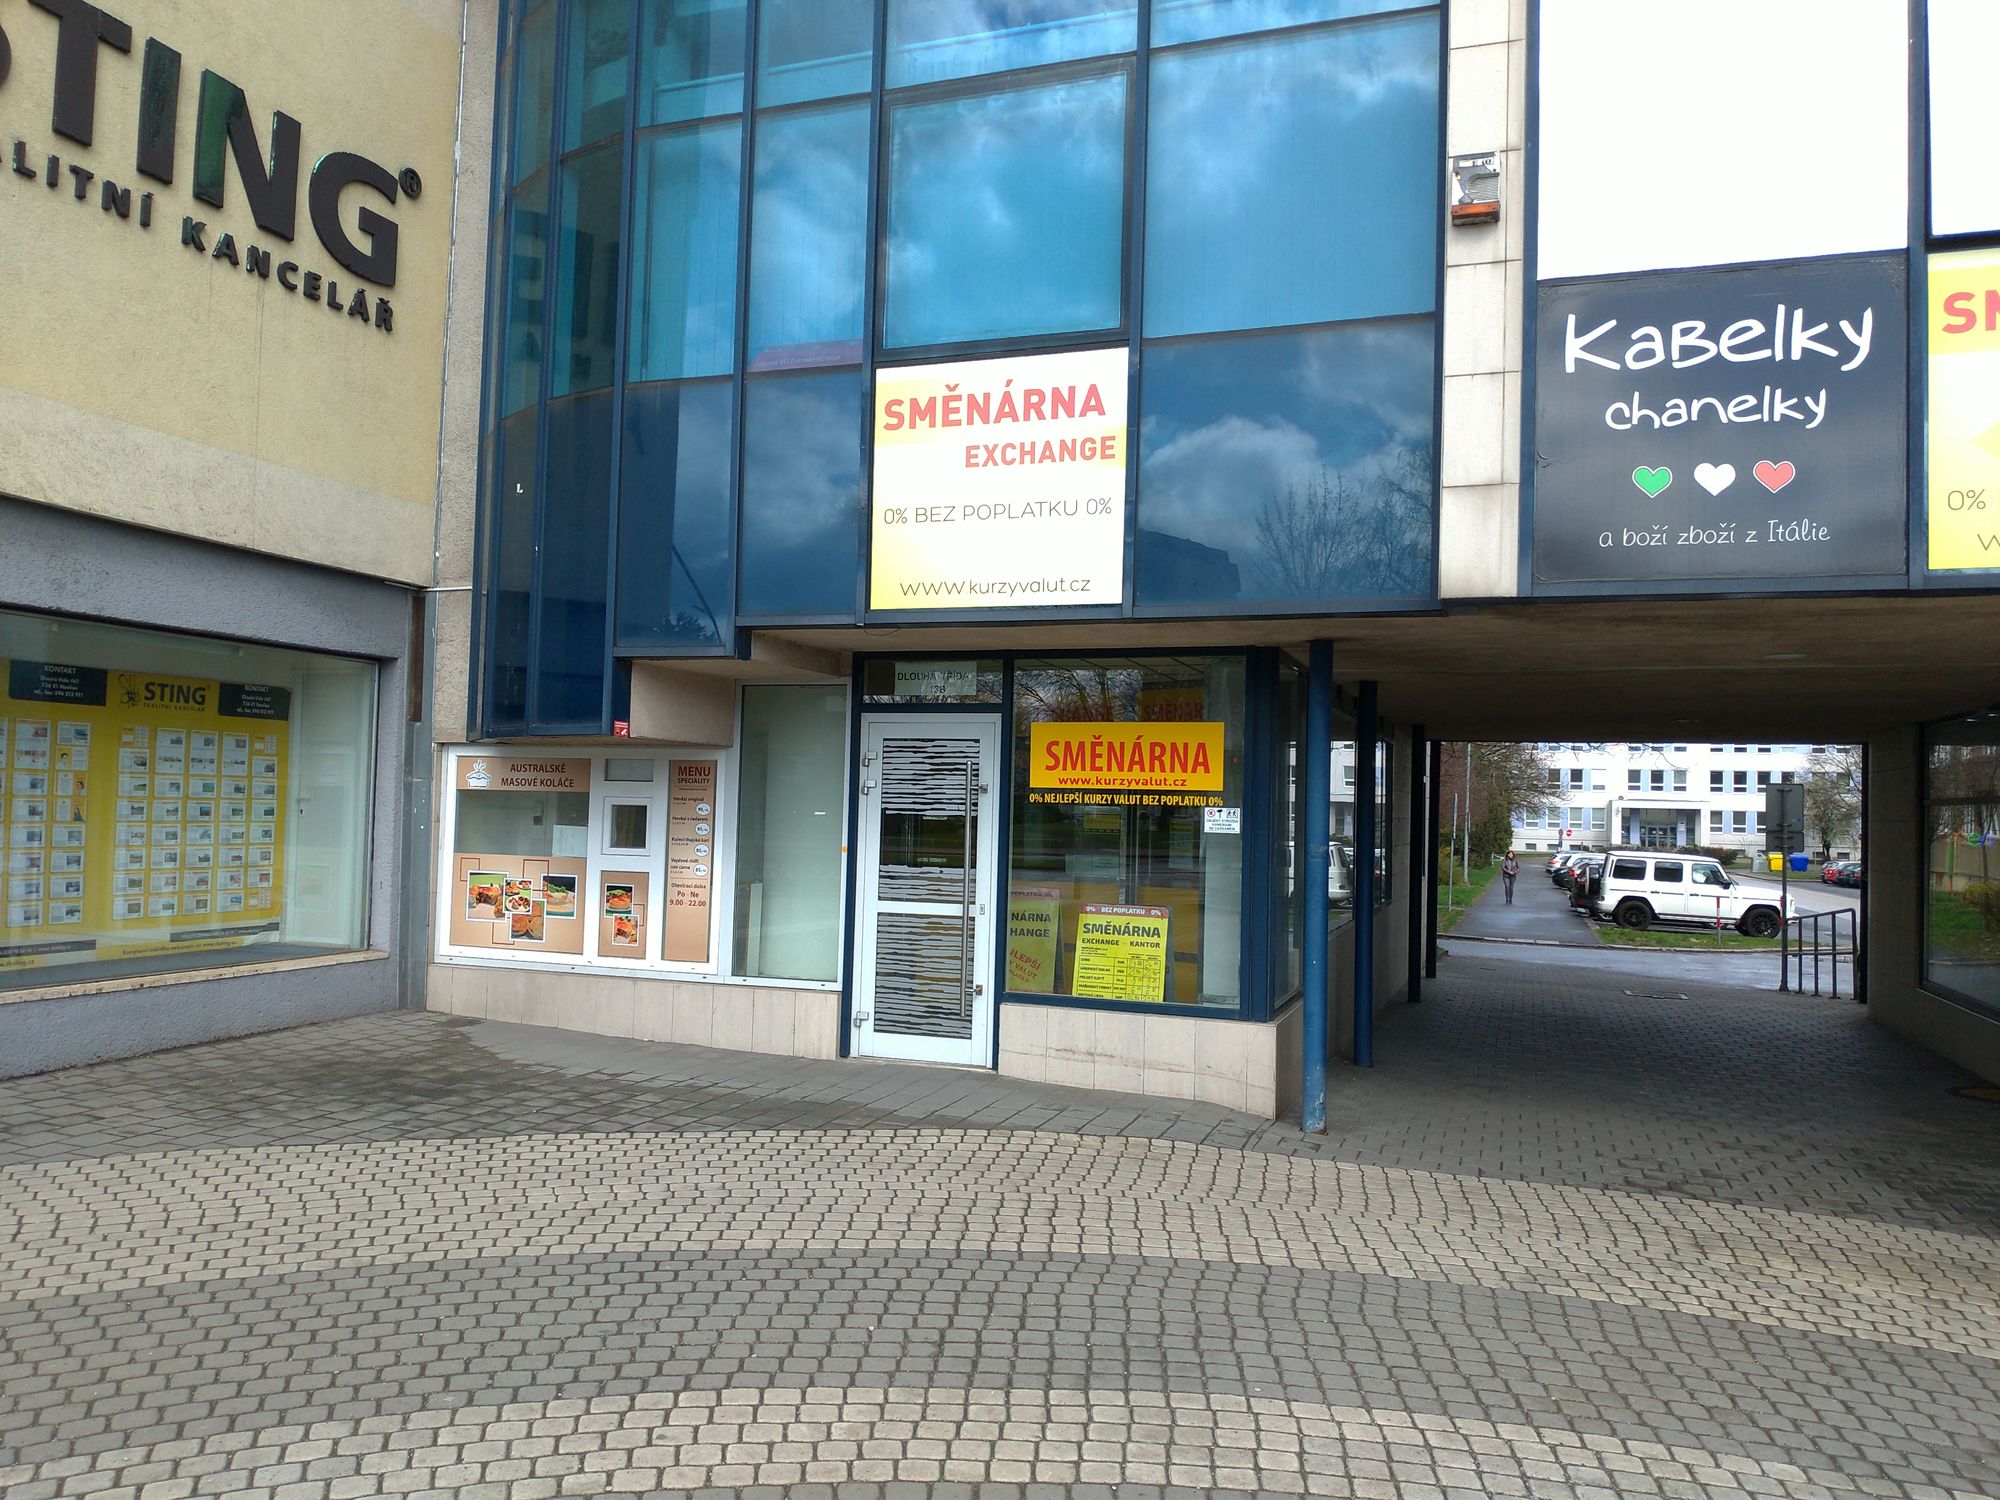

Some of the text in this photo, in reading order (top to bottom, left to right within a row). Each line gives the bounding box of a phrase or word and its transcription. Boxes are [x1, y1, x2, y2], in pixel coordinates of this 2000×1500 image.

[0, 140, 394, 332] LITNÍ KANCELÁŘ
[883, 379, 1106, 431] SMĚNÁRNA
[1604, 385, 1828, 430] chanelky
[964, 435, 1116, 469] EXCHANGE
[884, 496, 1112, 525] 0% BEZ POPLATKU 0%
[1598, 518, 1831, 548] a boží zboží z Itálie
[143, 681, 207, 706] STING
[1045, 734, 1211, 774] SMĚNÁRNA
[510, 763, 567, 774] AUSTRALSKÉ
[677, 766, 711, 777] MENU
[500, 776, 575, 788] MASOVÉ KOLÁČE
[1058, 776, 1188, 788] www.kurzyvalut.cz
[1029, 792, 1043, 803] 0%
[1044, 791, 1083, 804] NEJLEPŠÍ
[1083, 793, 1113, 805] KURZY
[1113, 794, 1141, 806] VALUT
[1142, 795, 1159, 806] BEZ
[1160, 795, 1207, 807] POPLATKU
[677, 890, 686, 898] Po
[690, 890, 700, 898] Ne
[688, 899, 707, 907] 22.00
[1011, 911, 1052, 922] NÁRNA
[1113, 907, 1146, 915] POPLATKU
[1010, 927, 1050, 938] HANGE
[1082, 920, 1161, 939] SMĚNÁRNA
[1081, 937, 1120, 946] EXCHANGE
[1129, 940, 1161, 949] KANTOR
